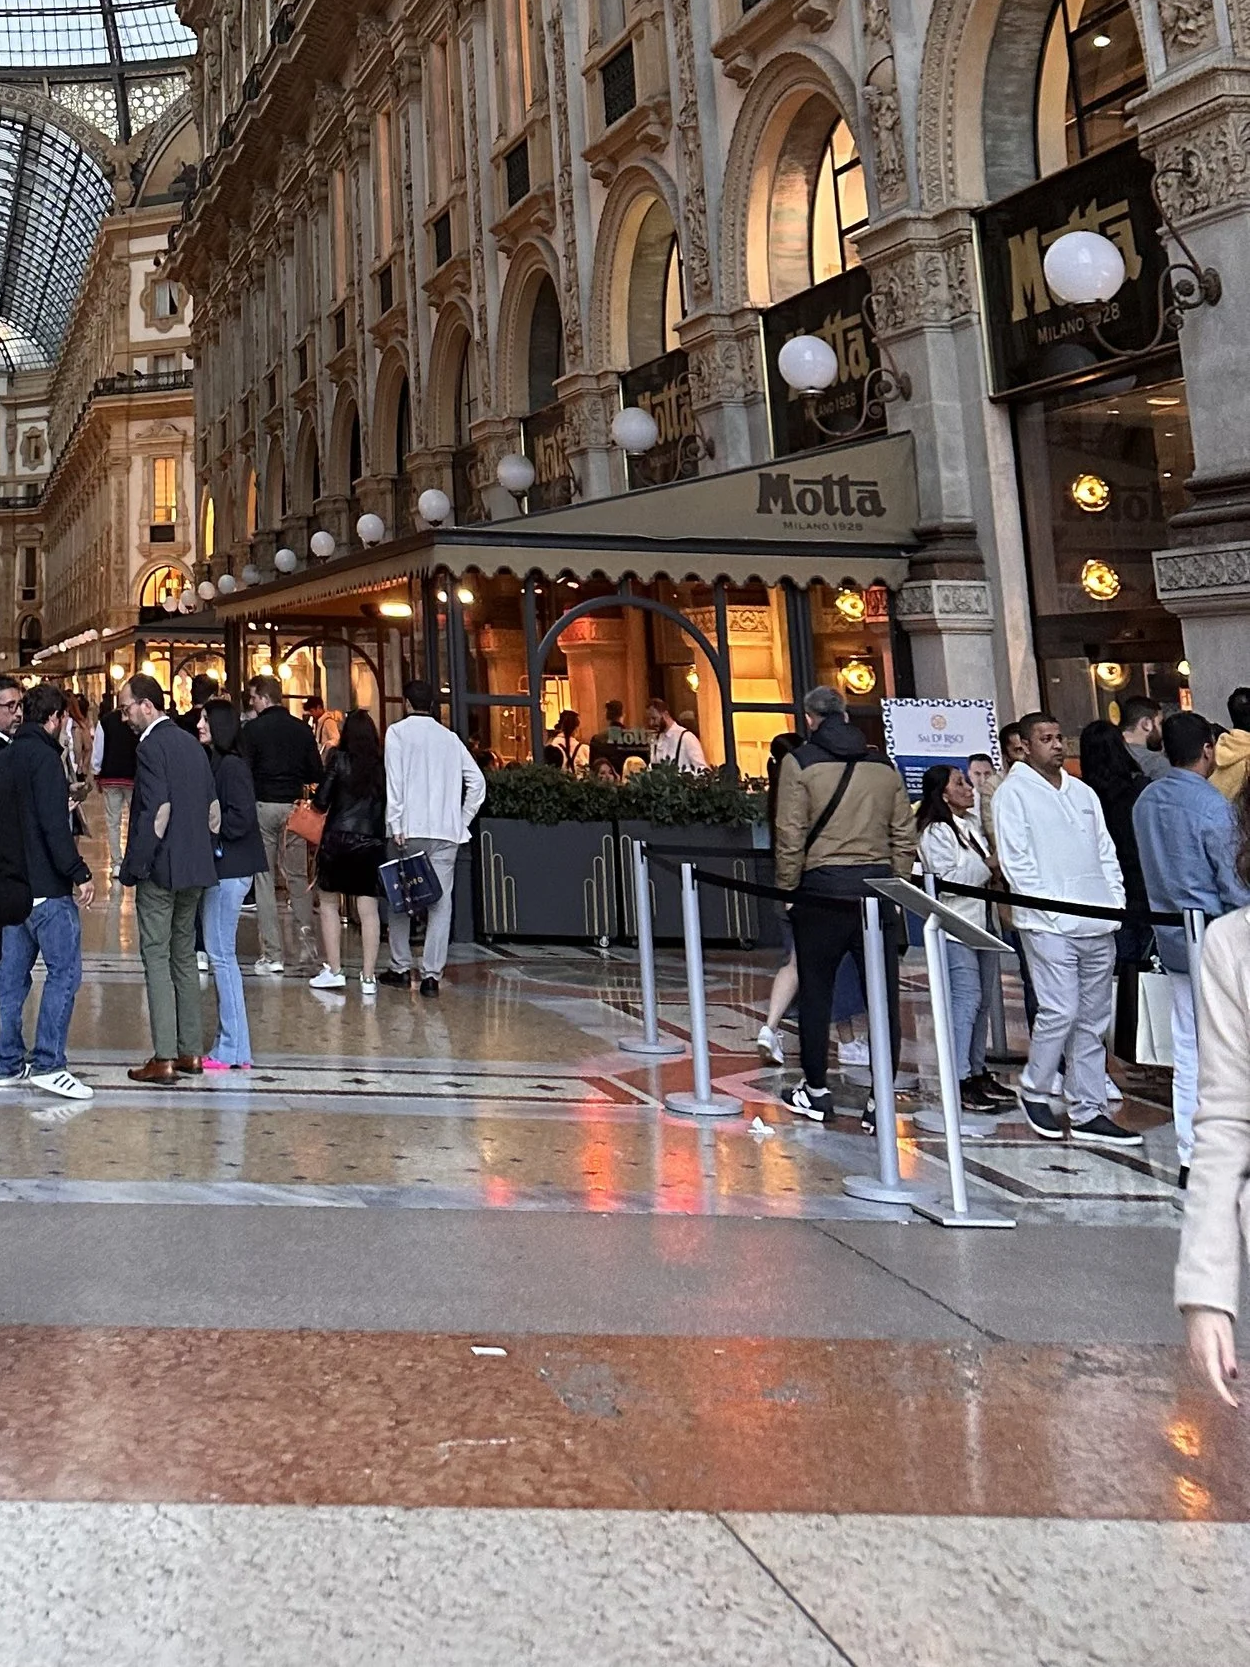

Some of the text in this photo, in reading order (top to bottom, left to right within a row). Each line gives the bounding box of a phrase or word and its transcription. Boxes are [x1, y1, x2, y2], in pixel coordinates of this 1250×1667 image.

[1037, 317, 1085, 345] MILANO
[756, 472, 887, 518] Motta
[782, 521, 863, 531] MILANO 1928
